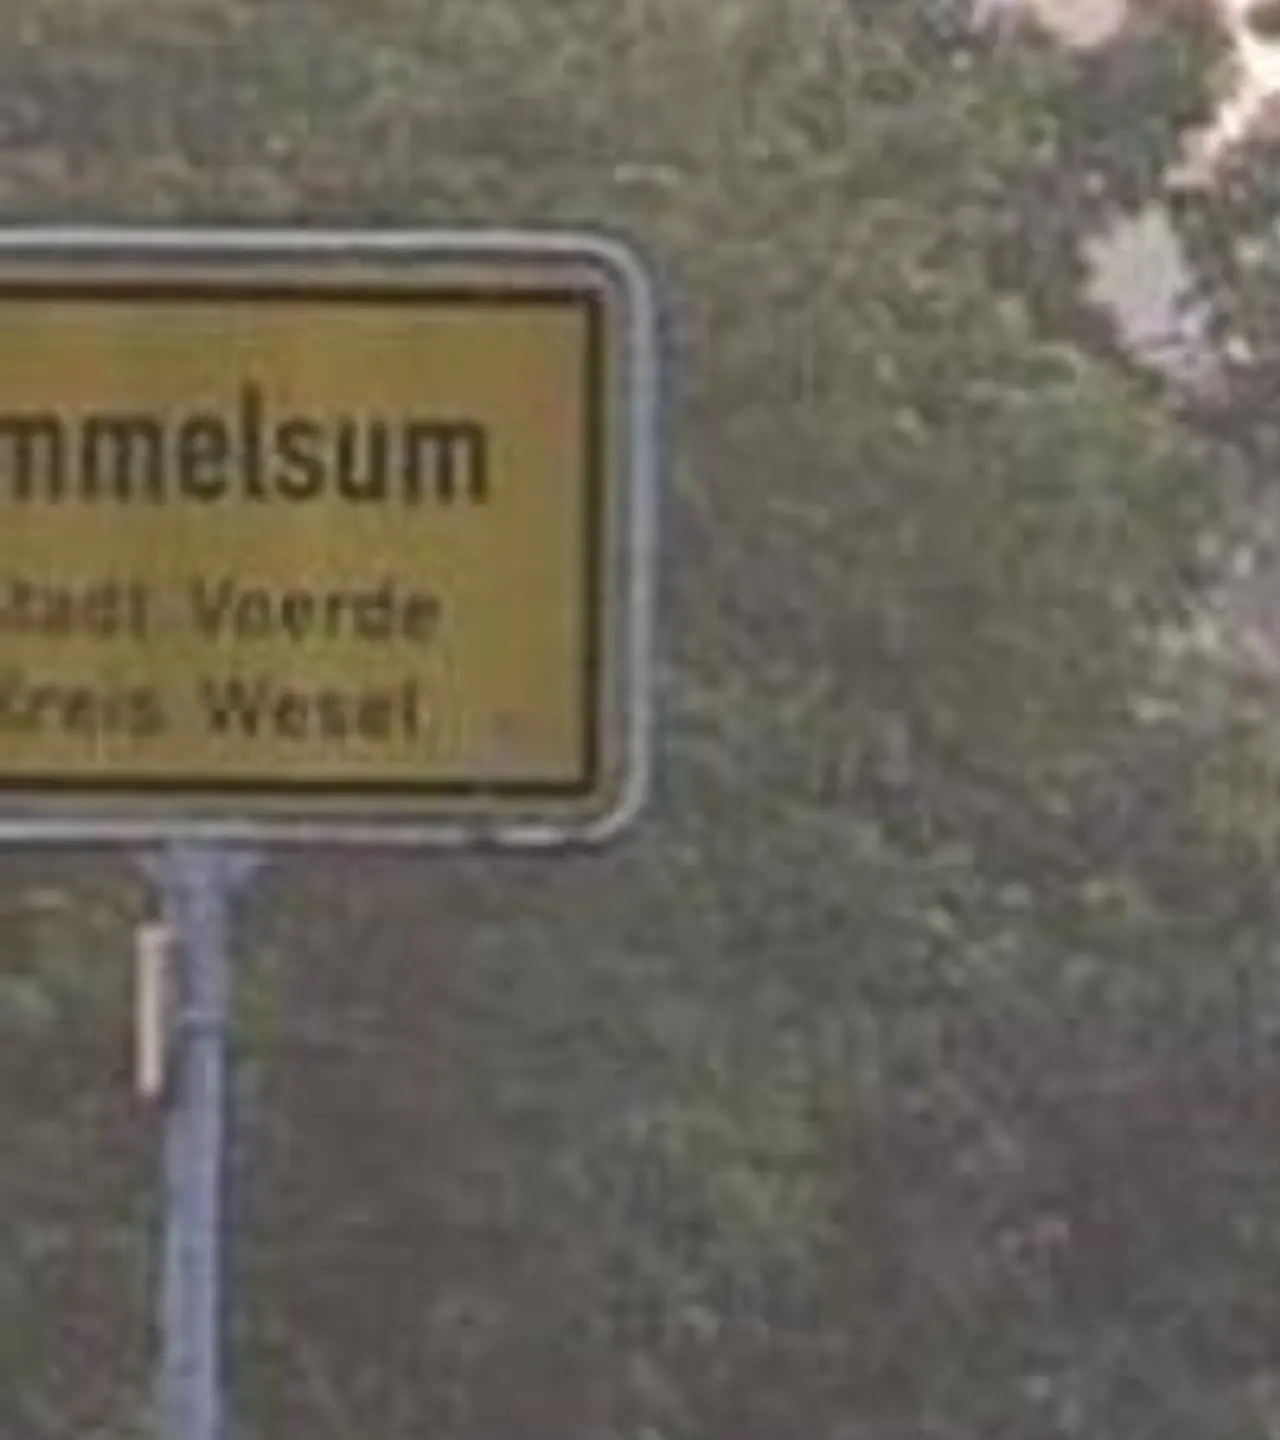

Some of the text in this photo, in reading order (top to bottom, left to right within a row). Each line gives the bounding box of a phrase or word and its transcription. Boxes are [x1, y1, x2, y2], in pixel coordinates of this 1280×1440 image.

[0, 380, 489, 505] mmelsum
[190, 570, 441, 642] Voerde
[201, 675, 417, 740] Wesel
